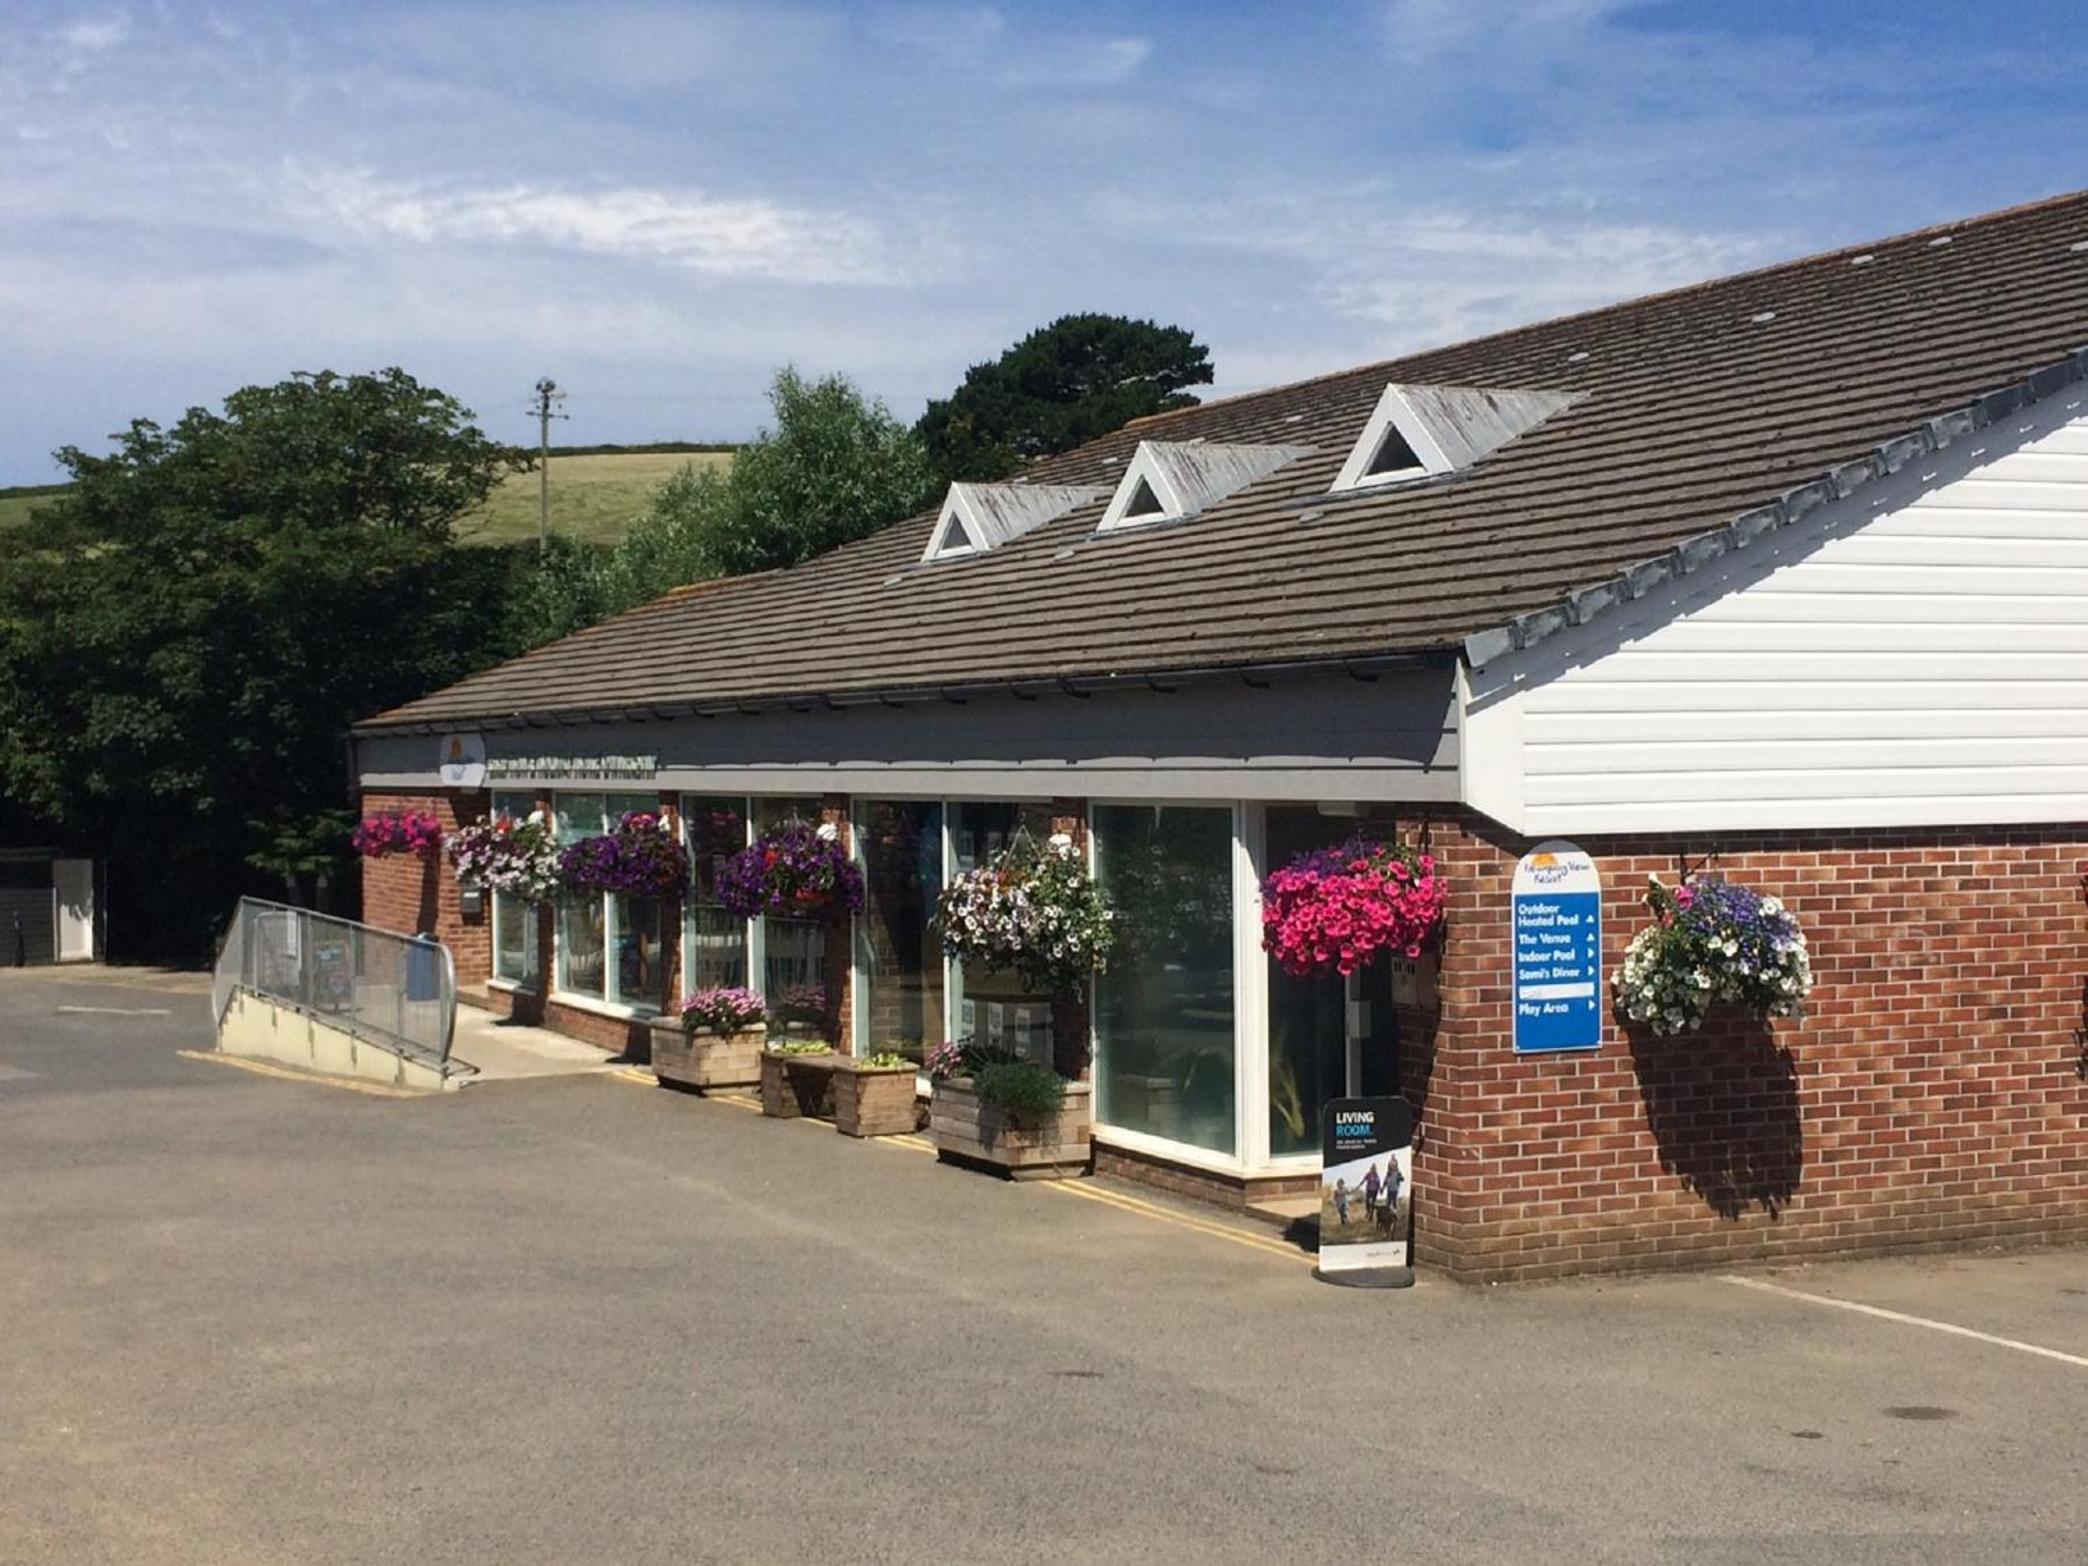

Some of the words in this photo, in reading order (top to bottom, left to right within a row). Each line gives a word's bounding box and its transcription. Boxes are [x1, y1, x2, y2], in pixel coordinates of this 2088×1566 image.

[1518, 903, 1559, 915] Outdoor
[1518, 915, 1555, 927] Heated
[1556, 914, 1579, 926] Pool
[1518, 933, 1537, 945] The
[1539, 933, 1571, 944] Venue
[1518, 950, 1552, 962] Indoor
[1553, 948, 1576, 961] Pool
[1552, 966, 1580, 978] Diner
[1518, 1002, 1541, 1018] Play
[1543, 1002, 1569, 1013] Area
[1336, 1111, 1375, 1124] LIVING
